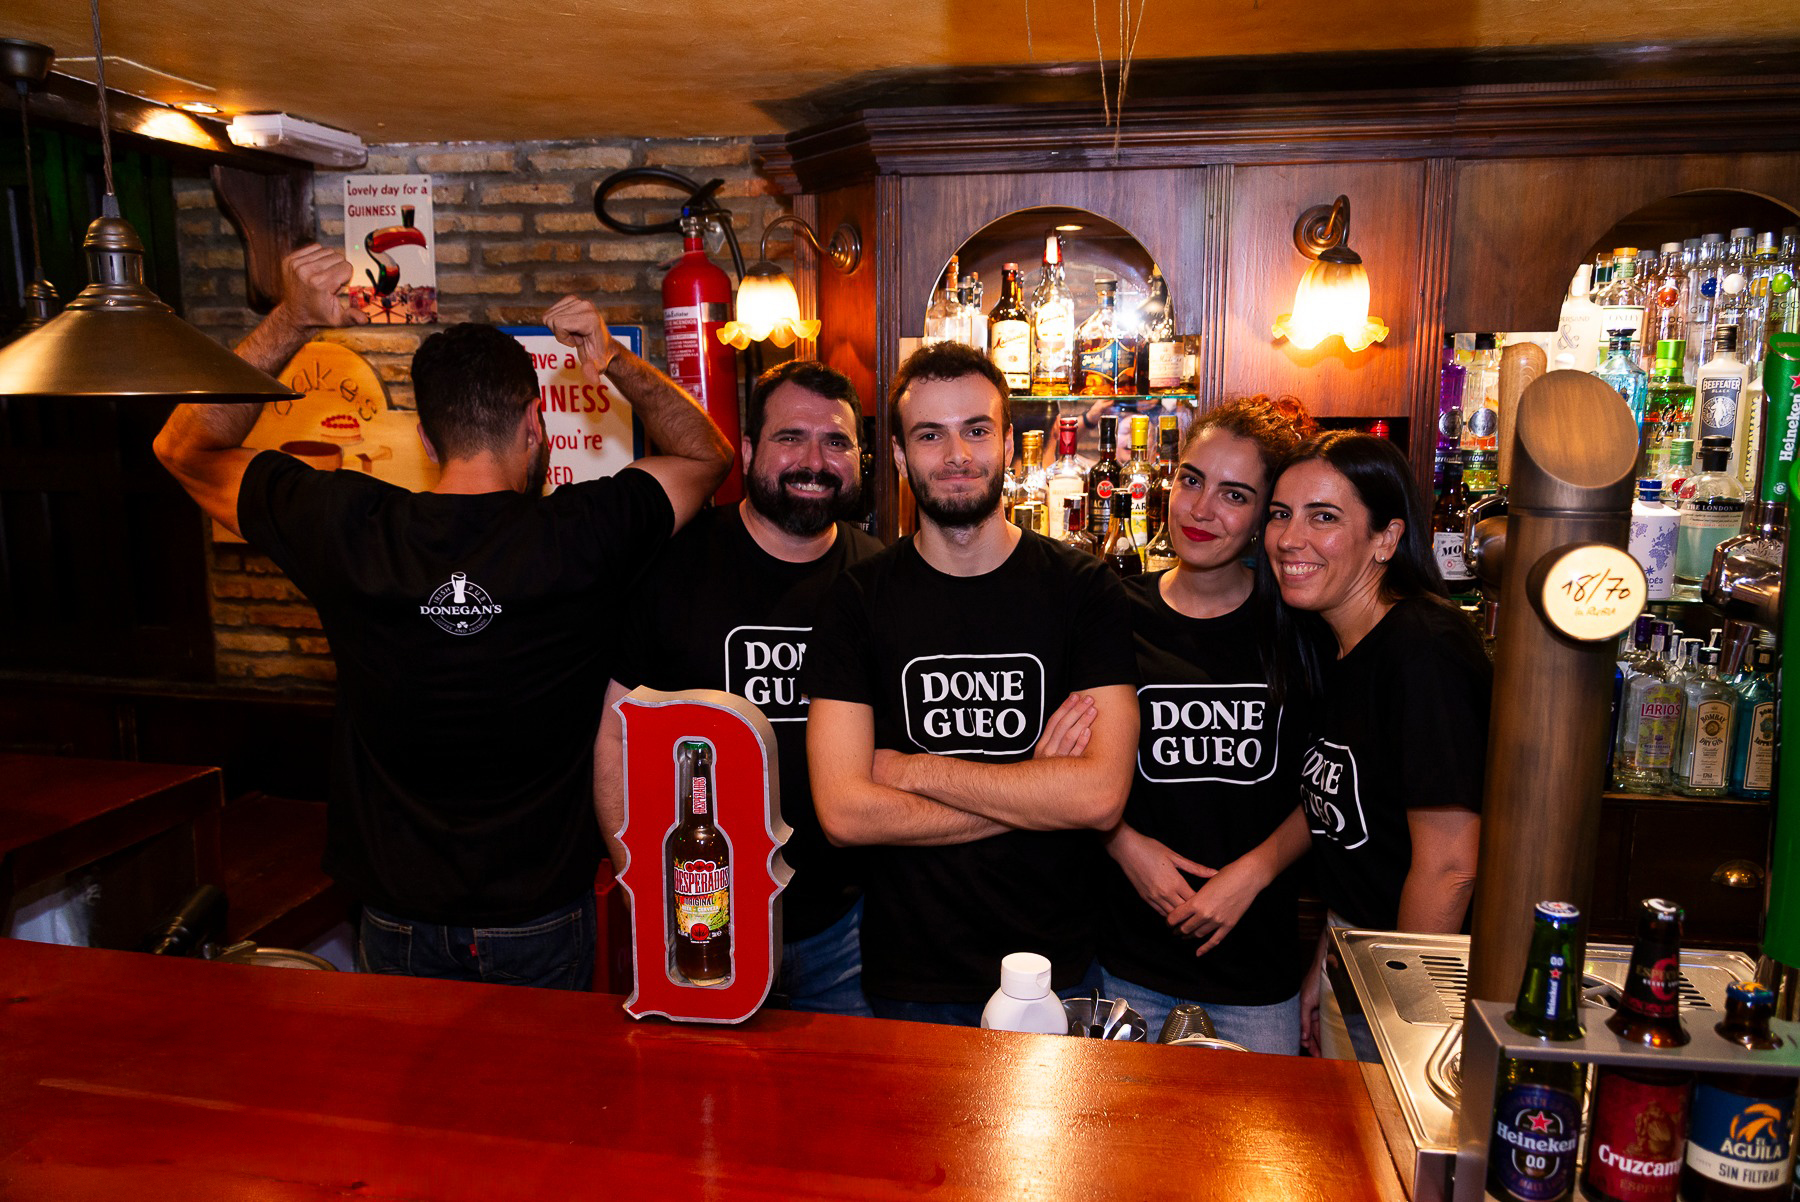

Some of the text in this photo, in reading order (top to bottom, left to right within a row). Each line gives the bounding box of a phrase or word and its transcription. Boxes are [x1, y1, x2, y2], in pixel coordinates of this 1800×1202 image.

[348, 183, 428, 197] Lovely day for a
[348, 205, 396, 217] GUINNESS
[529, 353, 577, 370] ave a
[1703, 379, 1741, 391] BEEFEATER
[1779, 393, 1800, 461] Heineken
[1686, 503, 1700, 512] THE
[1702, 504, 1733, 512] LONDON
[433, 585, 487, 604] IRISH PUB
[1561, 568, 1631, 604] 18/70
[419, 604, 503, 616] DONEGAN'S
[744, 676, 806, 705] GU
[920, 671, 1024, 703] DONE
[1150, 700, 1266, 730] DONE
[1641, 703, 1680, 718] LARIOS
[1700, 713, 1727, 724] BOMBAY
[923, 708, 1026, 738] GUEO
[1699, 737, 1711, 746] DRY
[1712, 738, 1723, 746] GIN
[1152, 736, 1262, 768] GUEO
[674, 868, 729, 894] DESPERADOS
[685, 897, 715, 906] ORIGINAL
[1497, 1121, 1576, 1153] Heineken
[1719, 1162, 1738, 1181] SIN
[1743, 1168, 1780, 1183] FILTRAR
